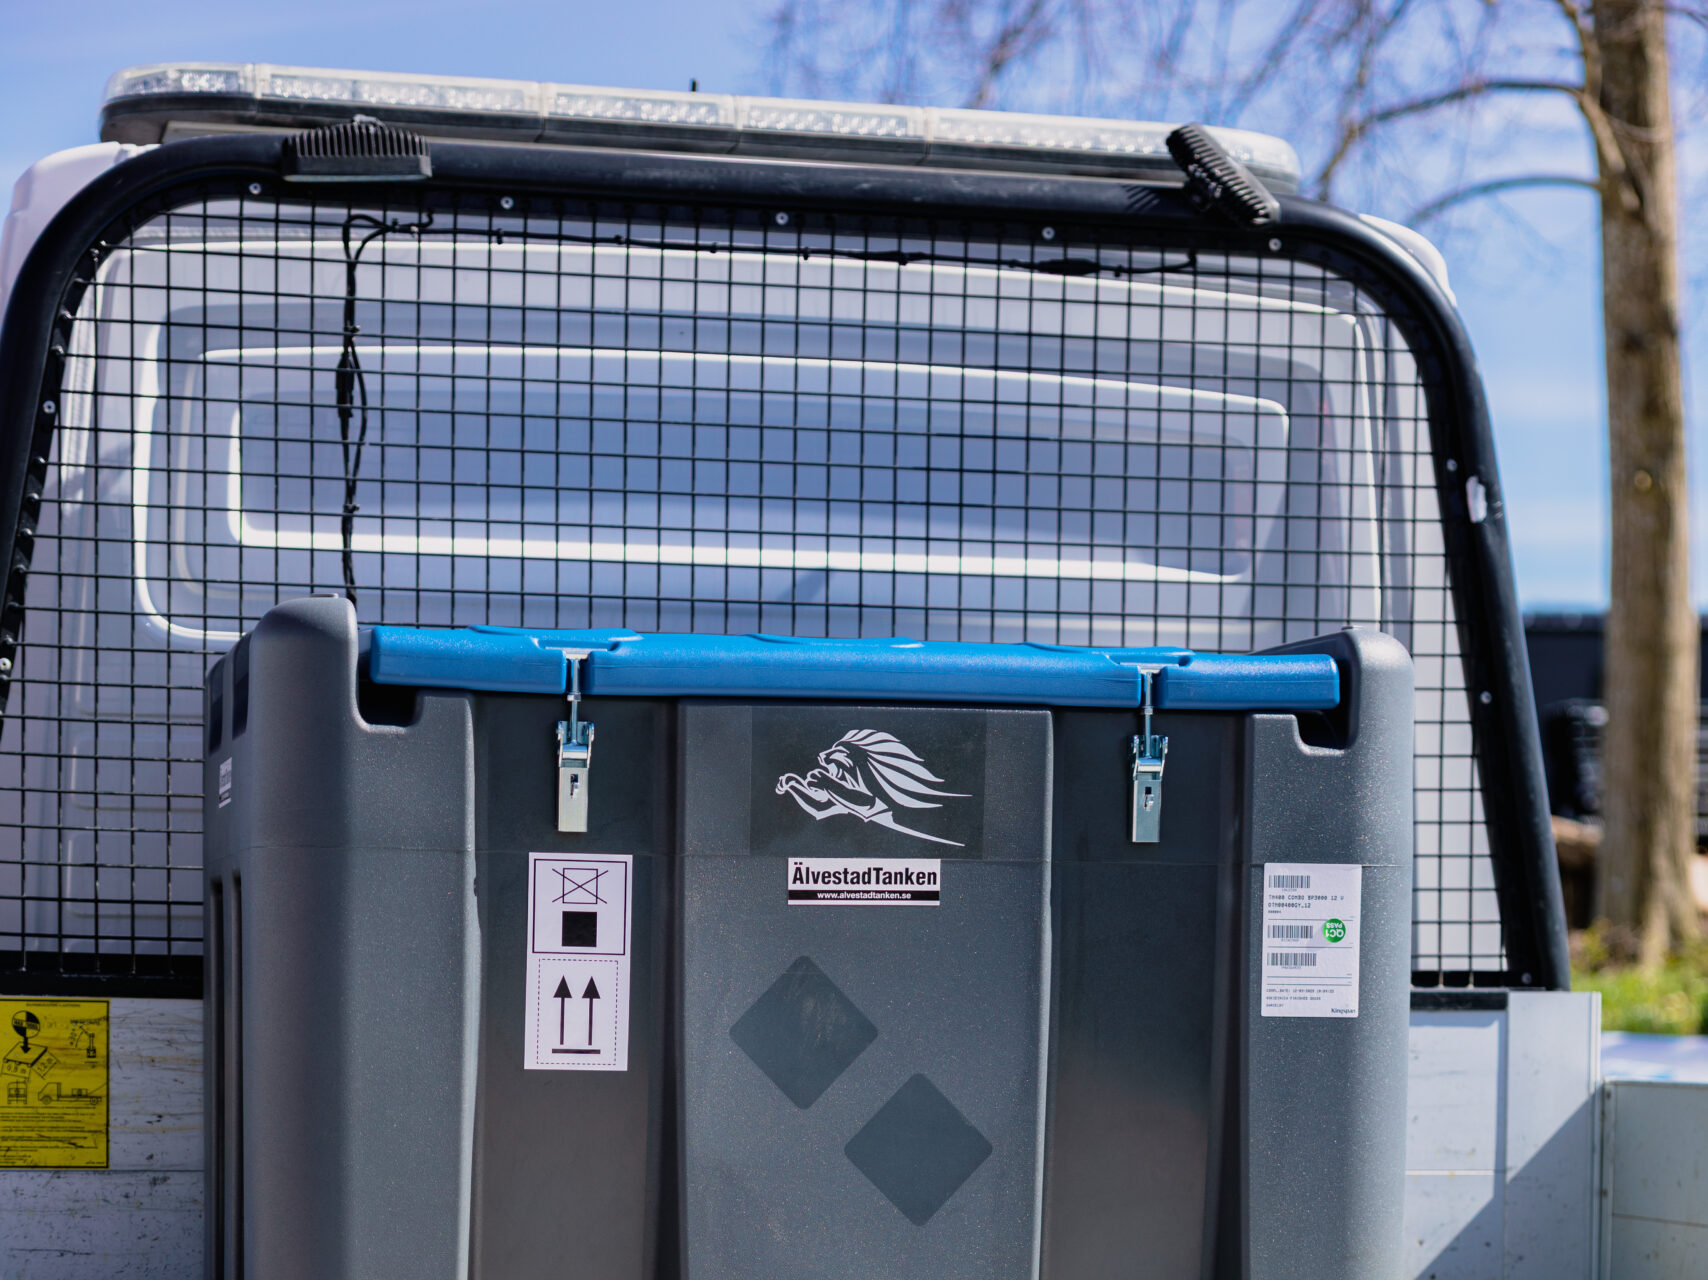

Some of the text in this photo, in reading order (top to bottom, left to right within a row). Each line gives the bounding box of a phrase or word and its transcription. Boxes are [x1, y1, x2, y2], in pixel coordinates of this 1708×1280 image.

[792, 862, 937, 885] ÄlvestadTanken
[817, 891, 911, 900] www.alvestadtanken.se
[1325, 929, 1344, 938] QC1
